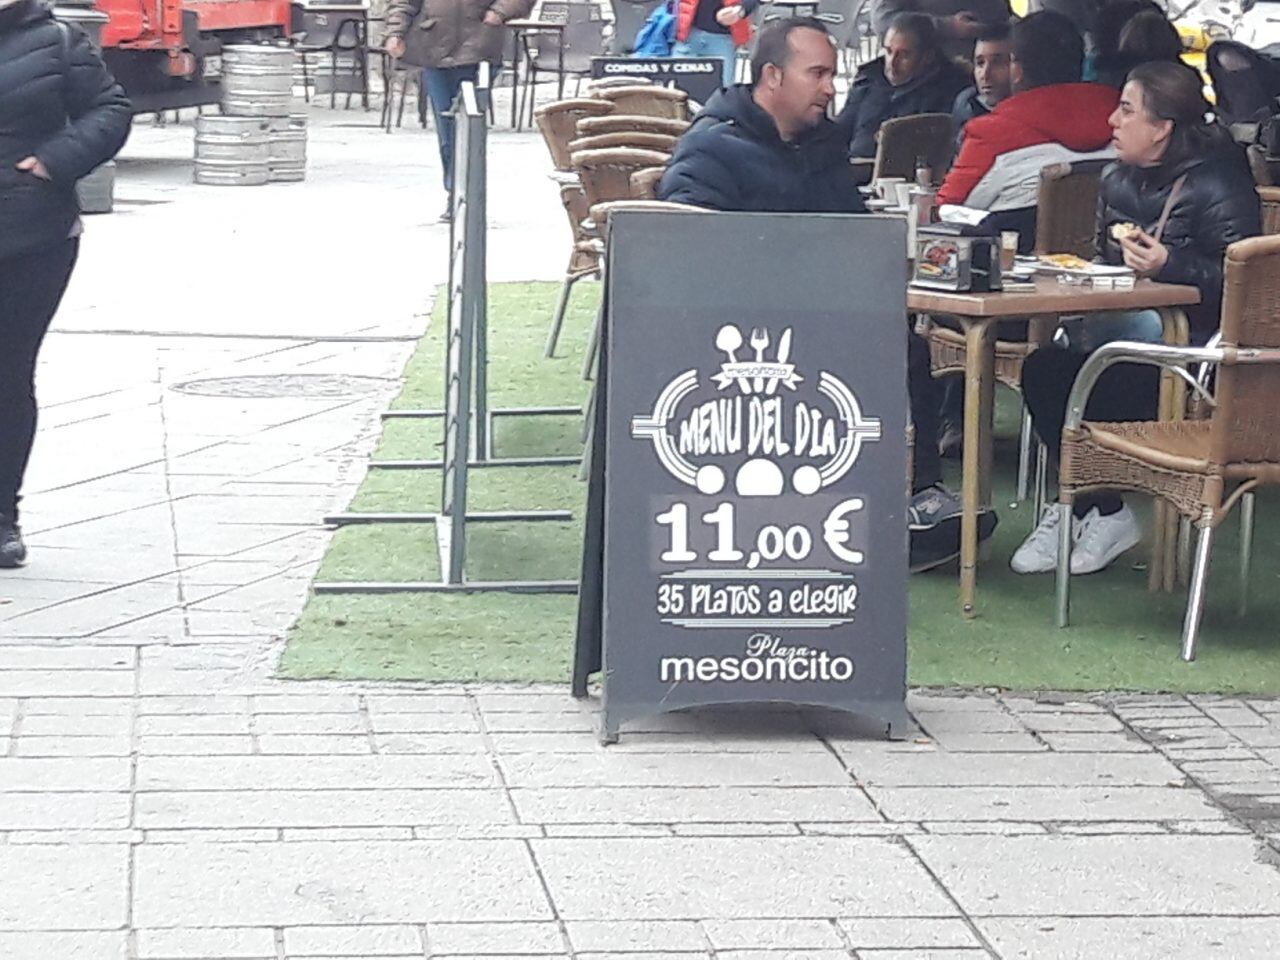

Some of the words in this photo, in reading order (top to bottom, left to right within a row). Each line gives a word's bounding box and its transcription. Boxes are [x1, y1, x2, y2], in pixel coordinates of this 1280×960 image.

[604, 63, 658, 73] COMIDAS
[661, 63, 670, 72] Y
[673, 62, 714, 73] CENAS
[679, 395, 742, 456] MENU
[747, 395, 790, 456] DEL
[794, 401, 836, 457] DIA
[656, 502, 812, 569] 11,00
[823, 498, 864, 563] €
[657, 584, 684, 614] 35
[767, 589, 783, 614] a
[746, 633, 811, 664] Plaza
[660, 650, 853, 680] mesoncito
